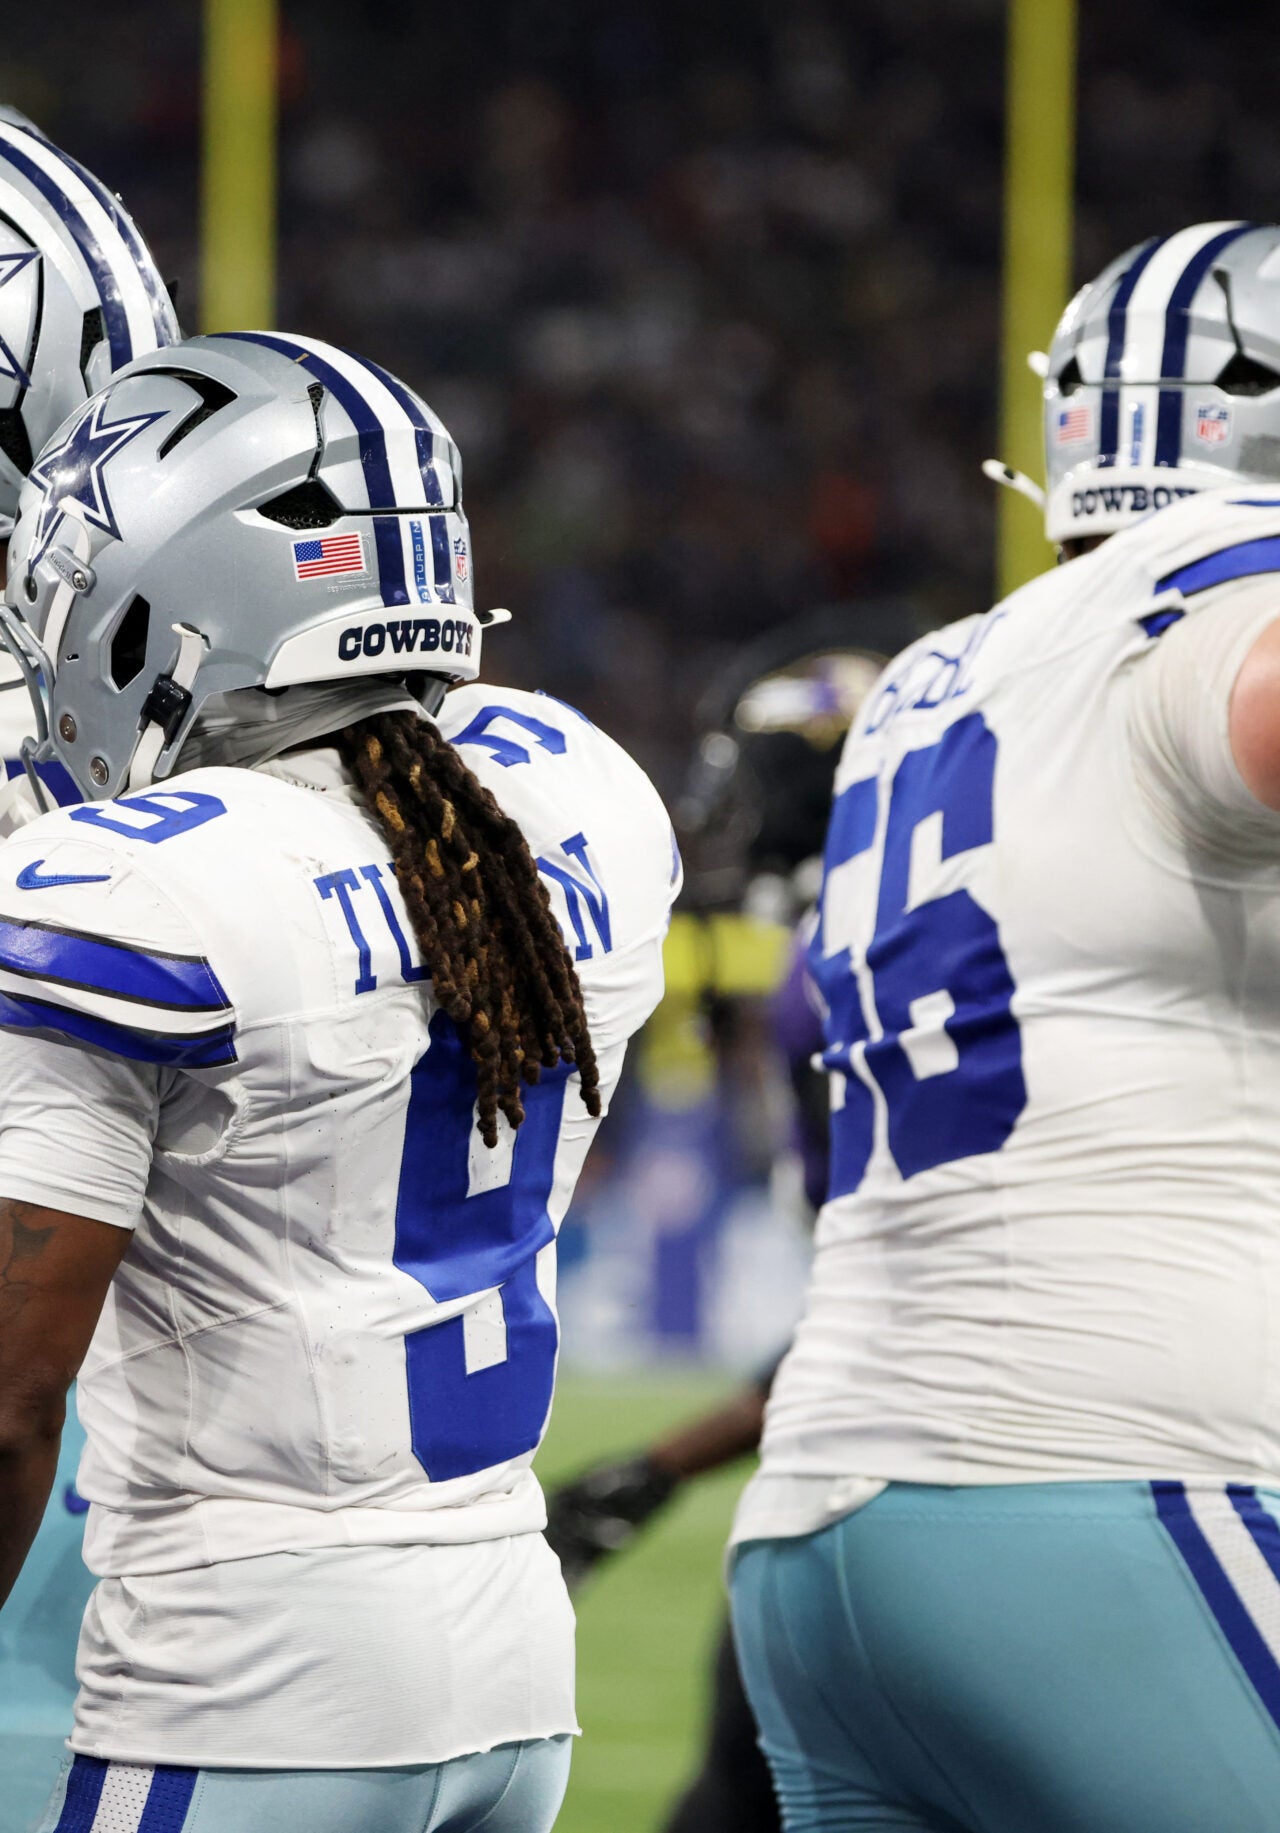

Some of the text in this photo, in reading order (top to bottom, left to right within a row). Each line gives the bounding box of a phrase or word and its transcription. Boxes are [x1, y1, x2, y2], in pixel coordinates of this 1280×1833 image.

[413, 521, 425, 583] TURPIN
[338, 618, 473, 661] COWBOYS
[68, 791, 228, 845] 9
[392, 1008, 558, 1484] 9
